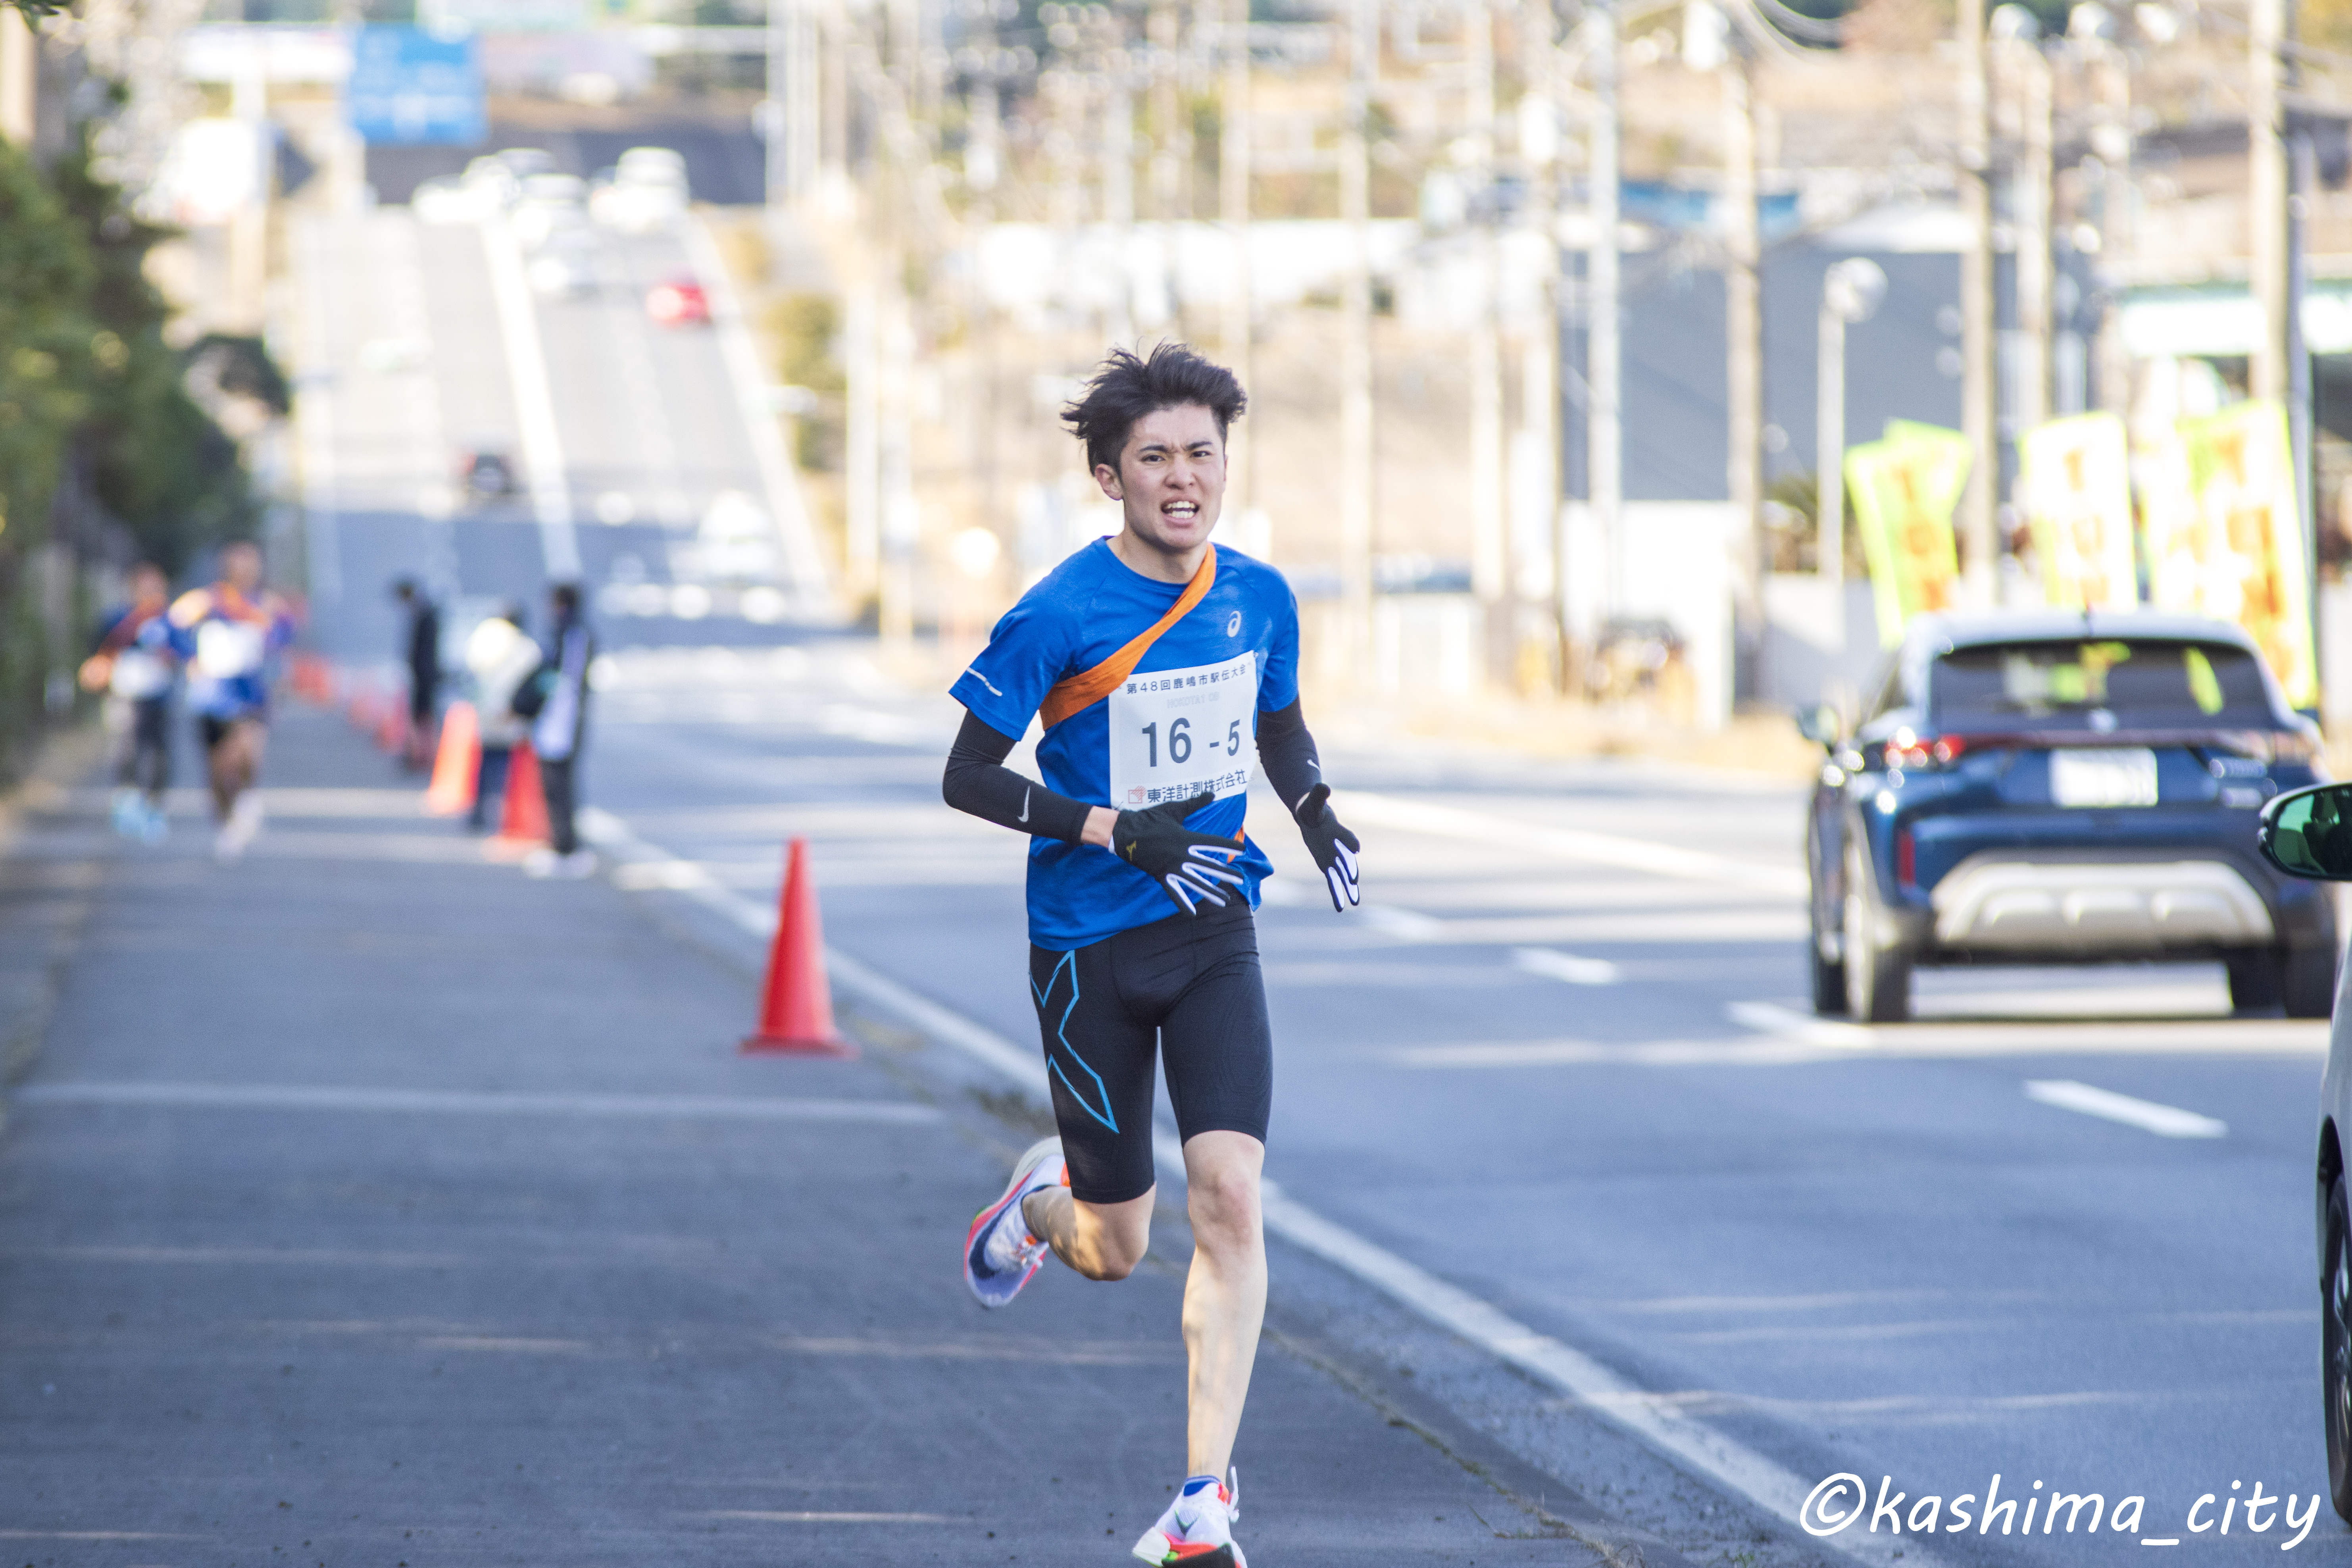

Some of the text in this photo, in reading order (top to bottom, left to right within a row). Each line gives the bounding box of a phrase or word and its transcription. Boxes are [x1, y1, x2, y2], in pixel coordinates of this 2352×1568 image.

[1147, 769, 1248, 803] 東洋計測株式会社
